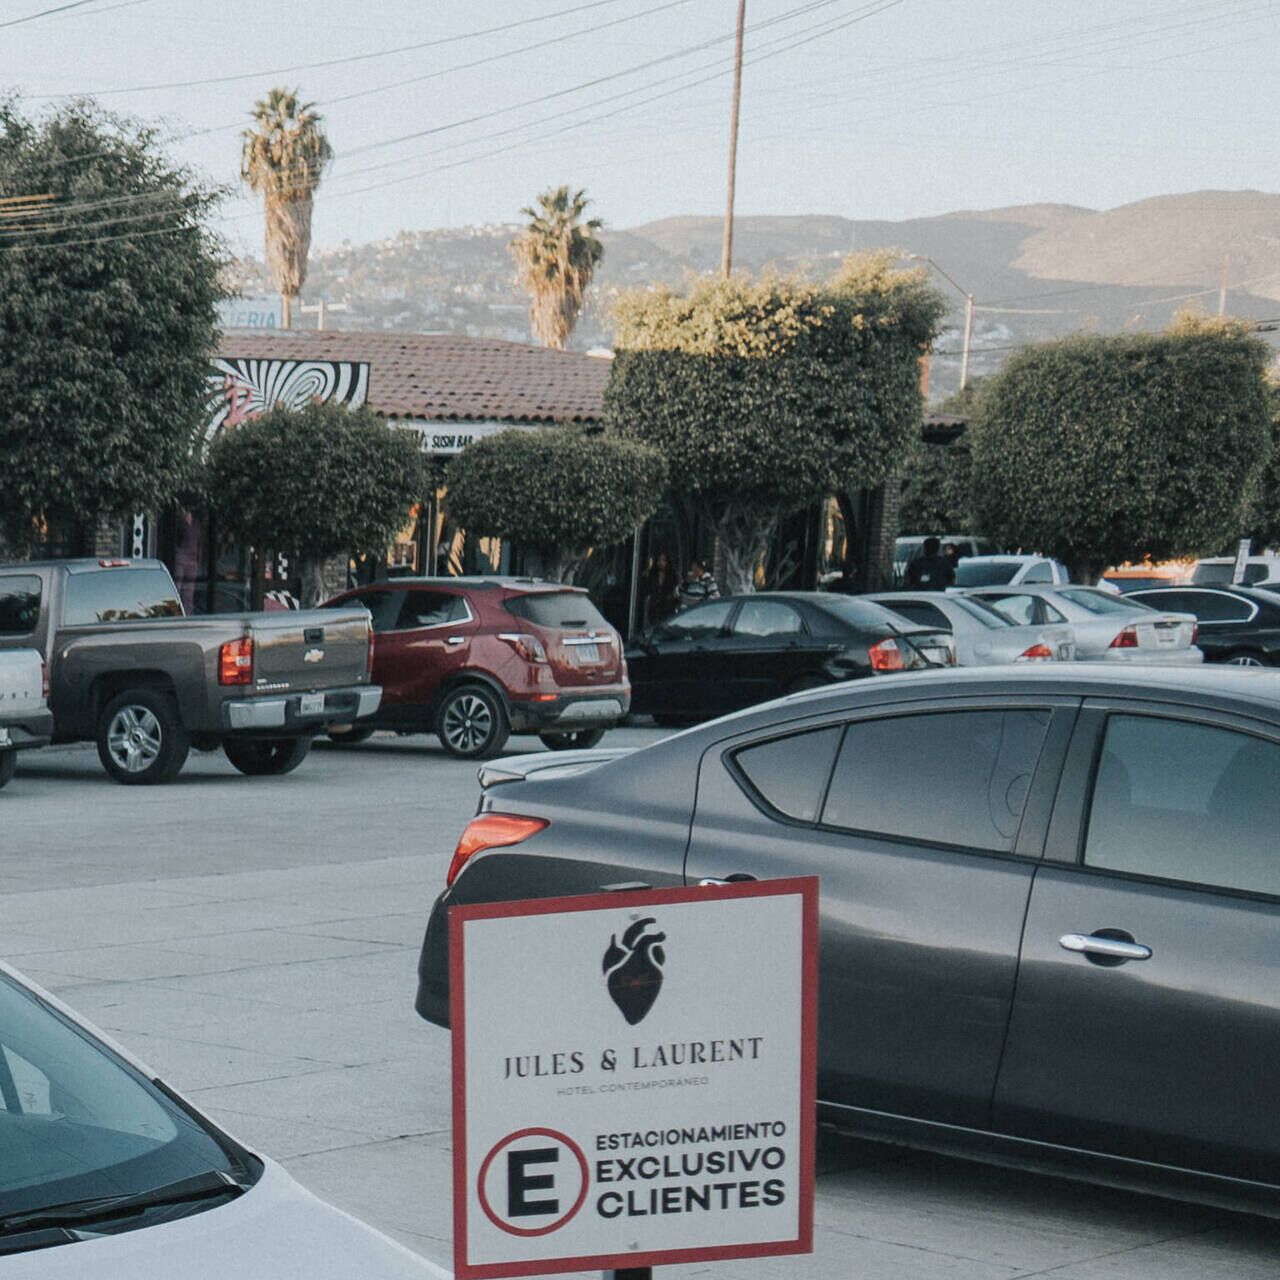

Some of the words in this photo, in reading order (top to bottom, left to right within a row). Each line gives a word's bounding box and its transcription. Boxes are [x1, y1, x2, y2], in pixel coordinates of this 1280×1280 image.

[432, 435, 456, 448] SUSHI
[504, 1051, 584, 1080] JULES
[601, 1048, 618, 1073] &
[633, 1037, 763, 1069] LAURENT
[557, 1086, 595, 1097] HOTEL
[596, 1120, 786, 1151] ESTACIONAMIENTO
[507, 1147, 560, 1218] E
[596, 1147, 786, 1183] EXCLUSIVO
[596, 1179, 786, 1219] CLIENTES
